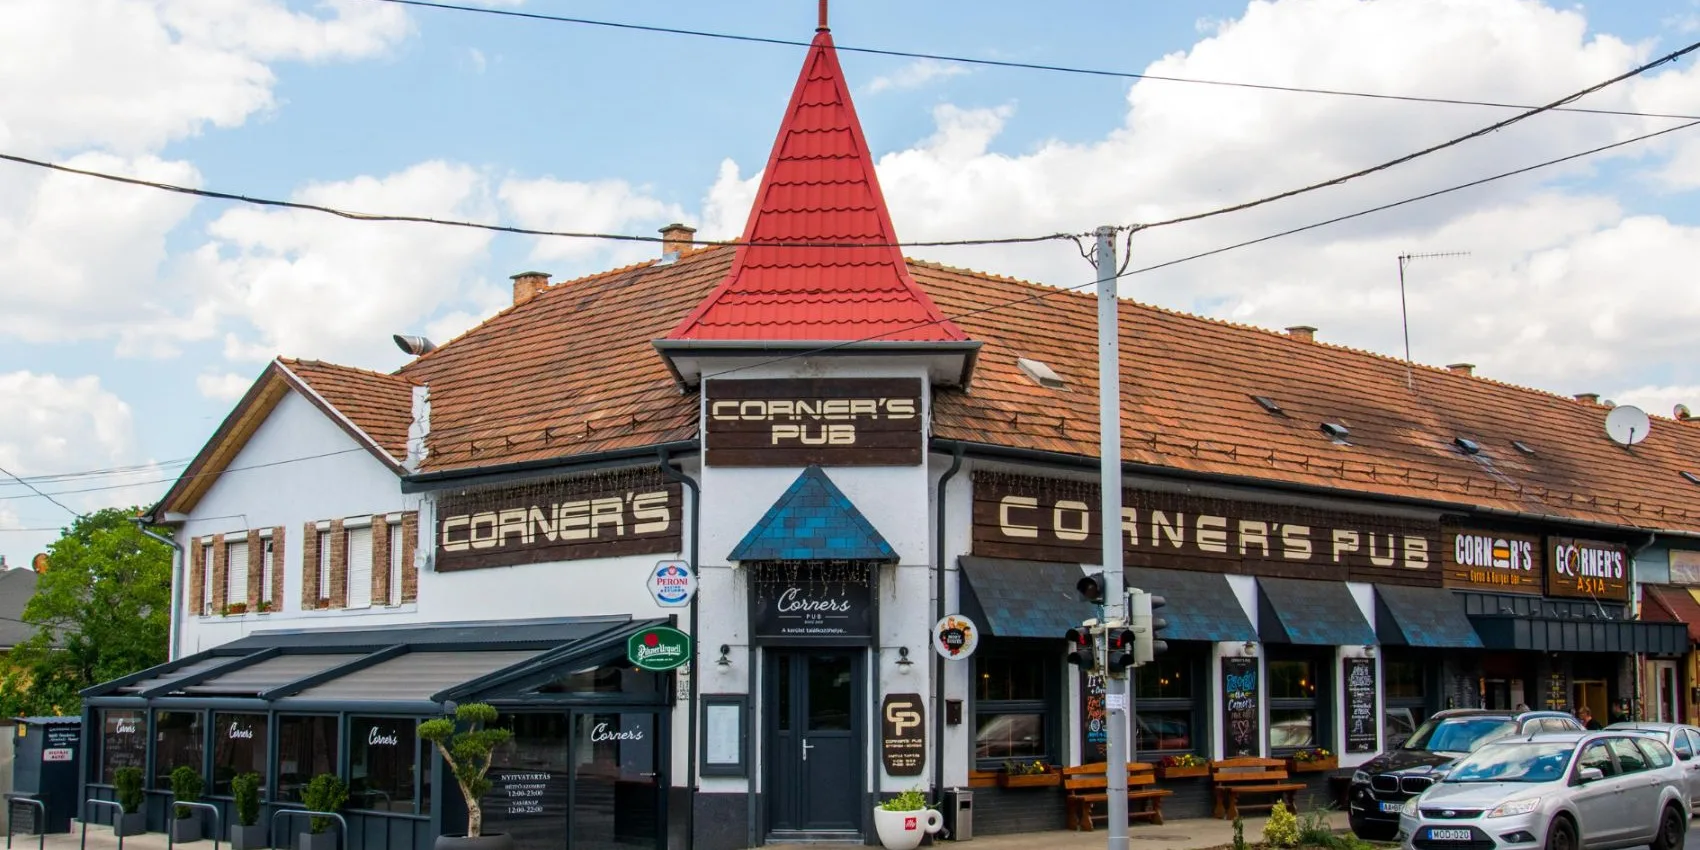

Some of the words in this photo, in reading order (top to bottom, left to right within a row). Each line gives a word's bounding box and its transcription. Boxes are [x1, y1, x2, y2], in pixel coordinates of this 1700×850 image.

[712, 398, 915, 421] CORNER'S
[772, 424, 856, 445] PUB
[443, 490, 670, 552] CORNER'S
[1332, 528, 1430, 569] PUB
[1556, 544, 1622, 579] CORNER'S
[656, 577, 688, 586] PERONI
[1577, 579, 1606, 594] ASIA
[369, 726, 398, 746] Corner's
[590, 722, 644, 742] Corner's
